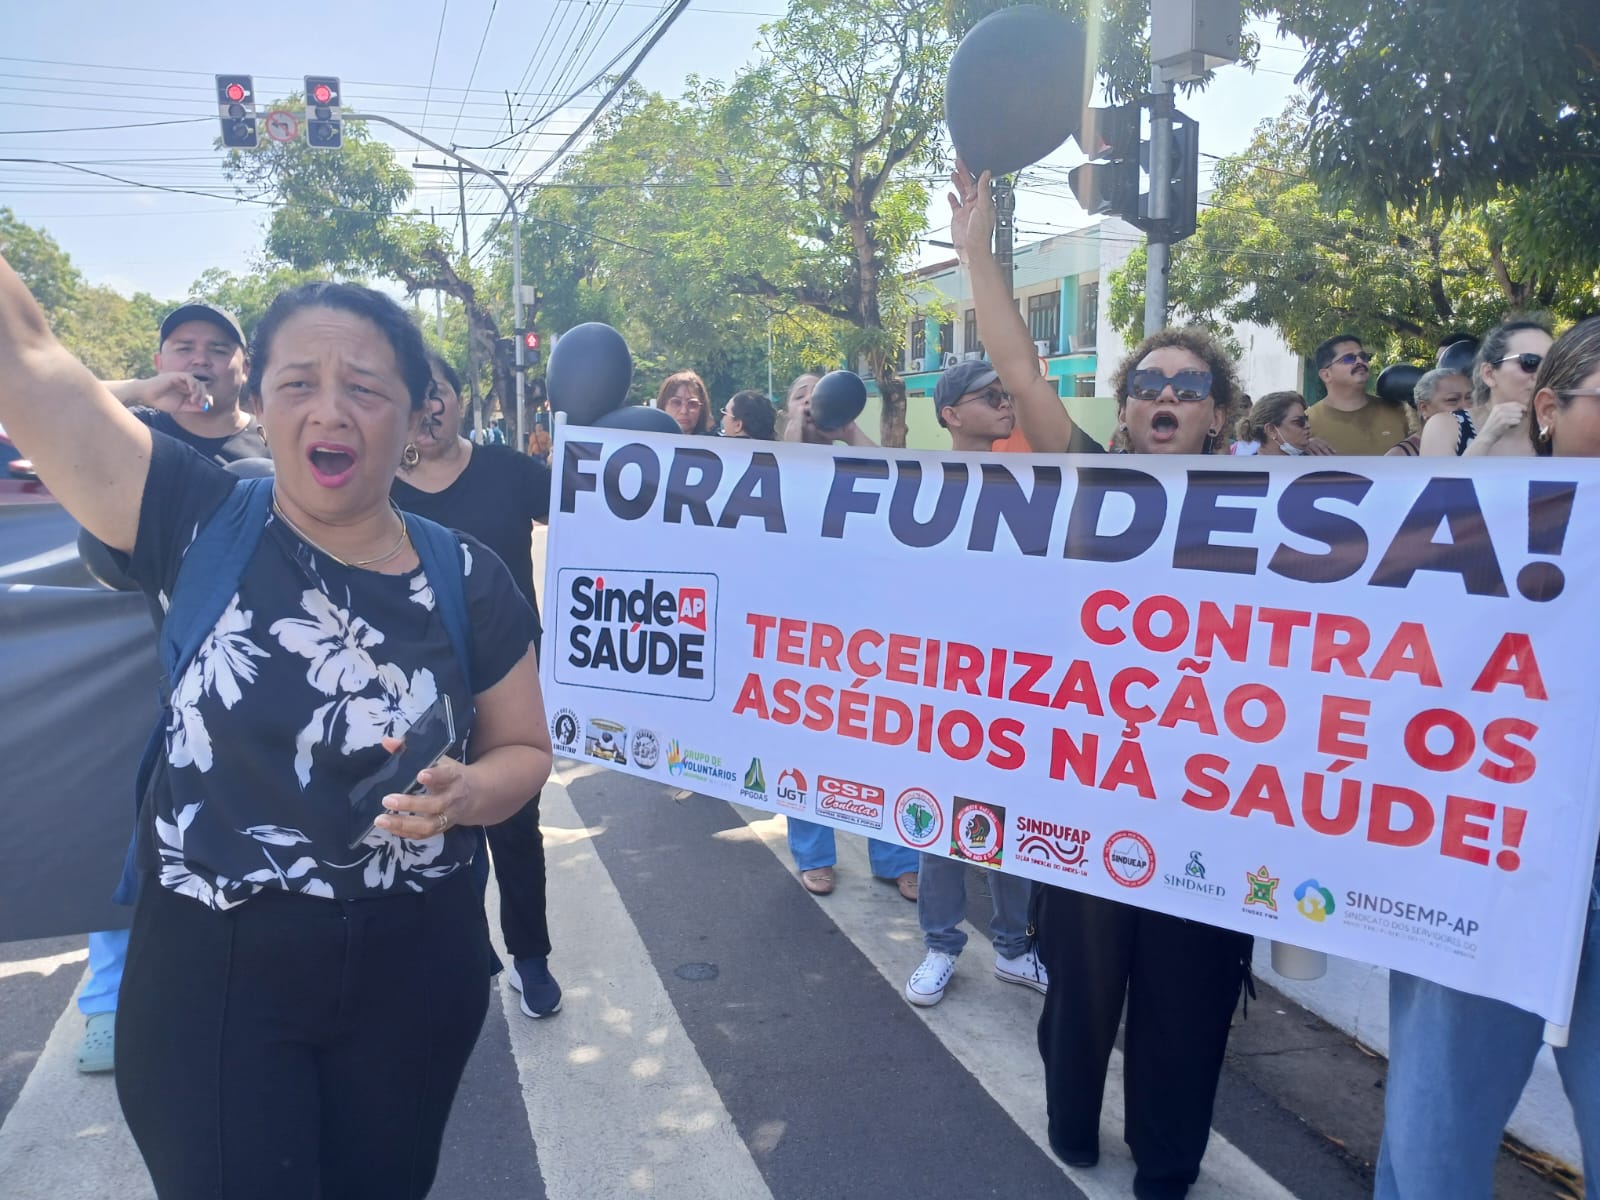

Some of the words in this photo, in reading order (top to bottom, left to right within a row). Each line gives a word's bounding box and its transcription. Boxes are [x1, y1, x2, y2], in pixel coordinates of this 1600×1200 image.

[560, 441, 787, 534] FORA
[821, 456, 1578, 603] FUNDESA!
[570, 576, 677, 626] Sinde
[680, 597, 705, 617] AP
[568, 623, 705, 680] SAÚDE
[1080, 589, 1442, 688] CONTRA
[1472, 631, 1549, 701] A
[746, 612, 1287, 743] TERCEIRIZAÇÃO
[1317, 694, 1371, 760] E
[1404, 708, 1539, 784] OS
[683, 761, 737, 782] VOLUNTÁRIOS
[684, 749, 710, 763] GRUPO
[712, 755, 722, 766] DE
[732, 673, 1026, 770] ASSÉDIOS
[1049, 728, 1157, 800] NA
[1181, 753, 1528, 872] SAÚDE!
[777, 786, 806, 804] UGT
[821, 794, 879, 818] Conlutas
[822, 780, 879, 799] CSP
[1017, 816, 1091, 845] SINDUFAP
[1163, 873, 1226, 897] SINDMED
[1345, 891, 1480, 937] SINDSEMP-AP
